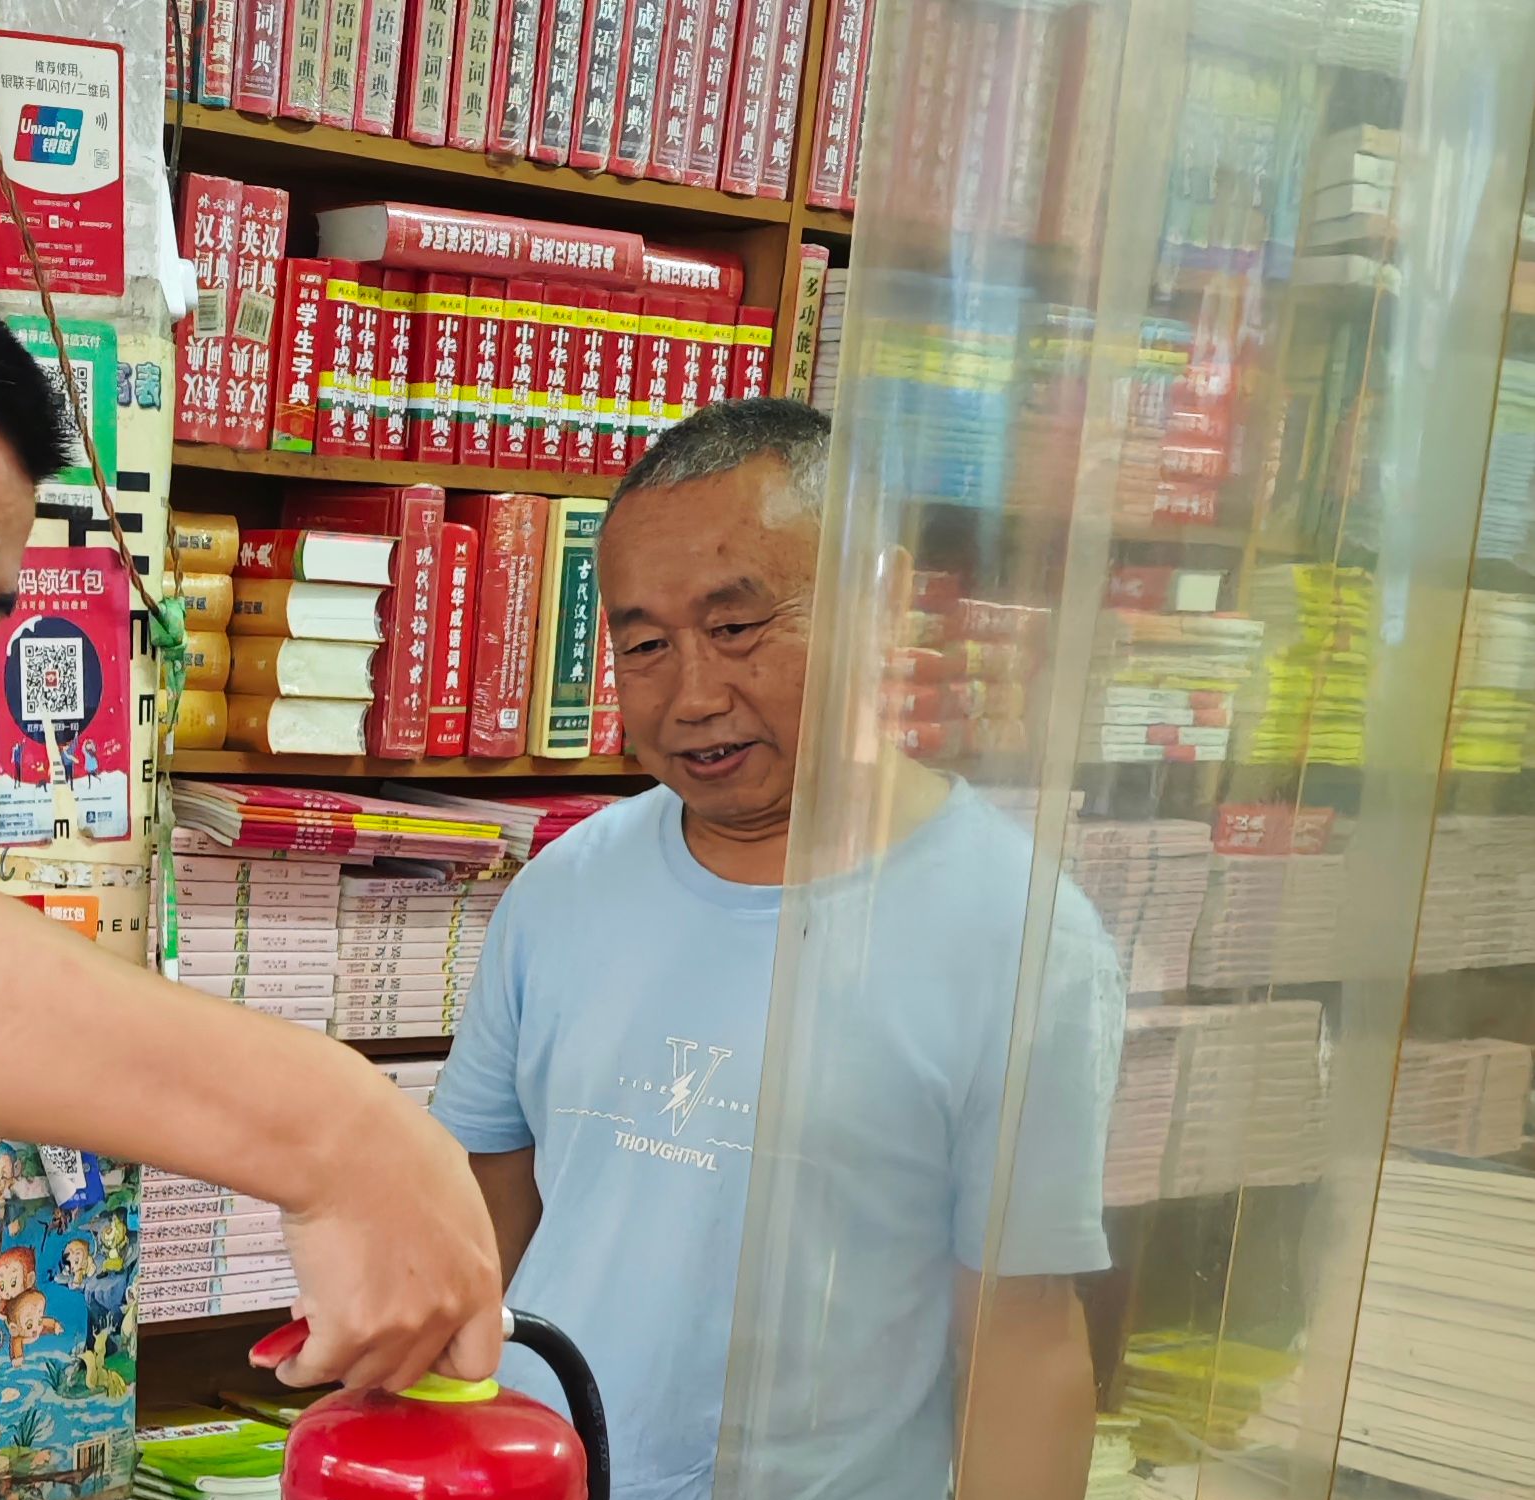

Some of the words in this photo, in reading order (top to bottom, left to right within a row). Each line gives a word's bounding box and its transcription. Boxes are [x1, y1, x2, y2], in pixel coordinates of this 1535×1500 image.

[251, 1, 275, 73] 词典
[330, 2, 356, 96] 语词典
[370, 8, 397, 100] 语词典
[624, 4, 658, 135] 成语词典
[1, 74, 110, 99] 银联手机闪付/二维码
[20, 117, 79, 141] UnionPay
[771, 6, 803, 166] 语成语词典
[42, 138, 73, 155] 银联
[194, 212, 236, 251] 汉英
[194, 250, 230, 290] 词典
[237, 256, 277, 297] 词典
[238, 219, 281, 259] 英汉
[182, 373, 221, 410] 英汉
[225, 379, 268, 415] 汉英
[288, 302, 318, 406] 学生字典
[386, 313, 411, 435] 中华成语词典
[431, 316, 460, 438] 中华成语词典
[473, 319, 499, 442] 中华成语词典
[507, 322, 536, 443] 中华成语词典
[543, 326, 570, 447] 中华成语词典
[576, 330, 604, 448] 中华成语词典
[610, 334, 635, 450] 中华成语词典
[444, 566, 468, 690] 新华成语词典
[569, 560, 593, 684] 古代汉语词典
[618, 1076, 667, 1095] TIDE
